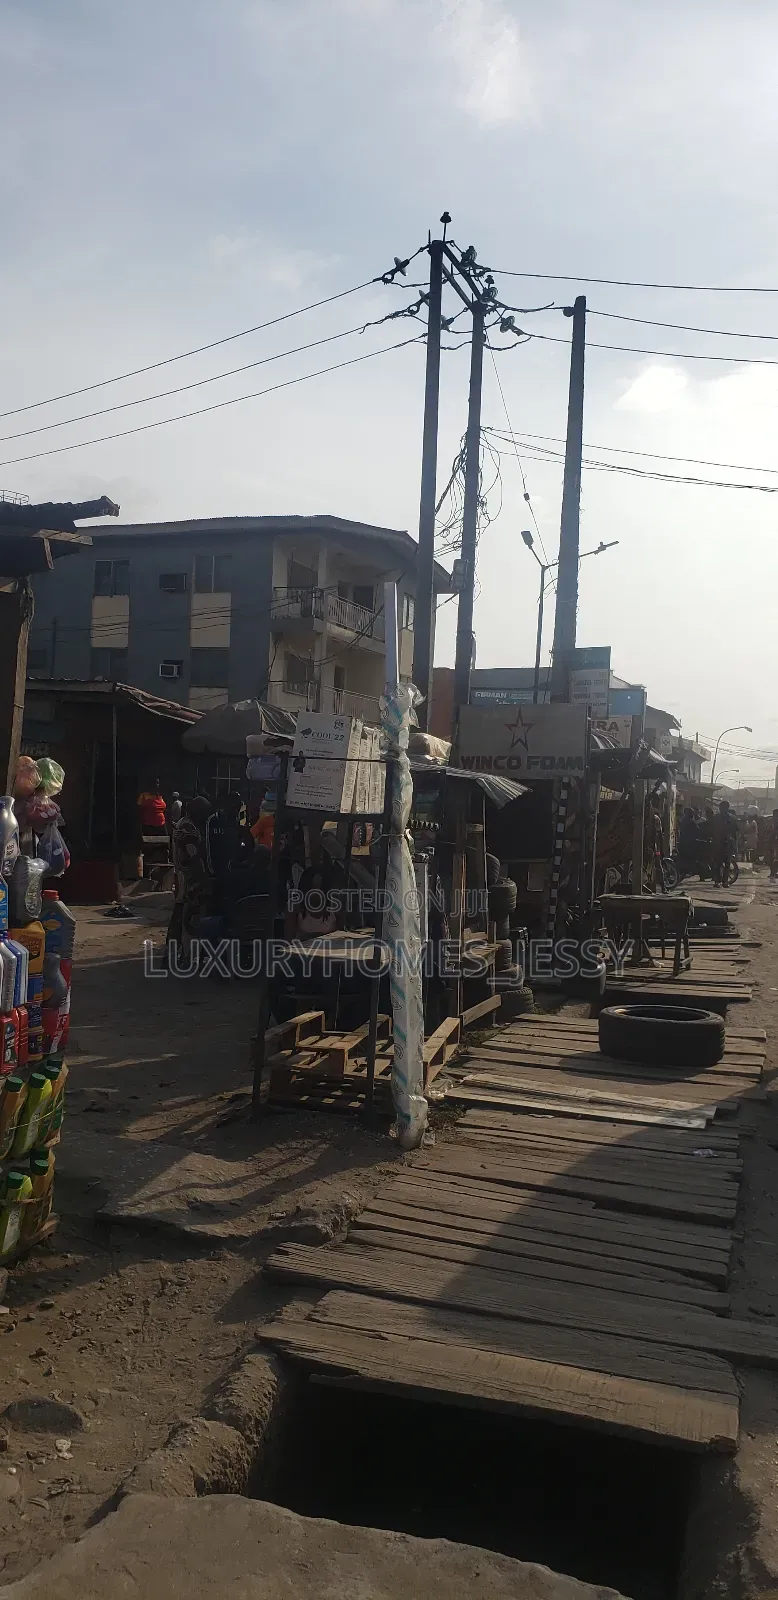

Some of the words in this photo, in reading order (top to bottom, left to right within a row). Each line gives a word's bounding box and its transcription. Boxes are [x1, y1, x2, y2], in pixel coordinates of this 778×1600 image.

[475, 691, 507, 700] FIRMAN
[461, 756, 522, 770] WINCO
[526, 756, 583, 770] FOAM
